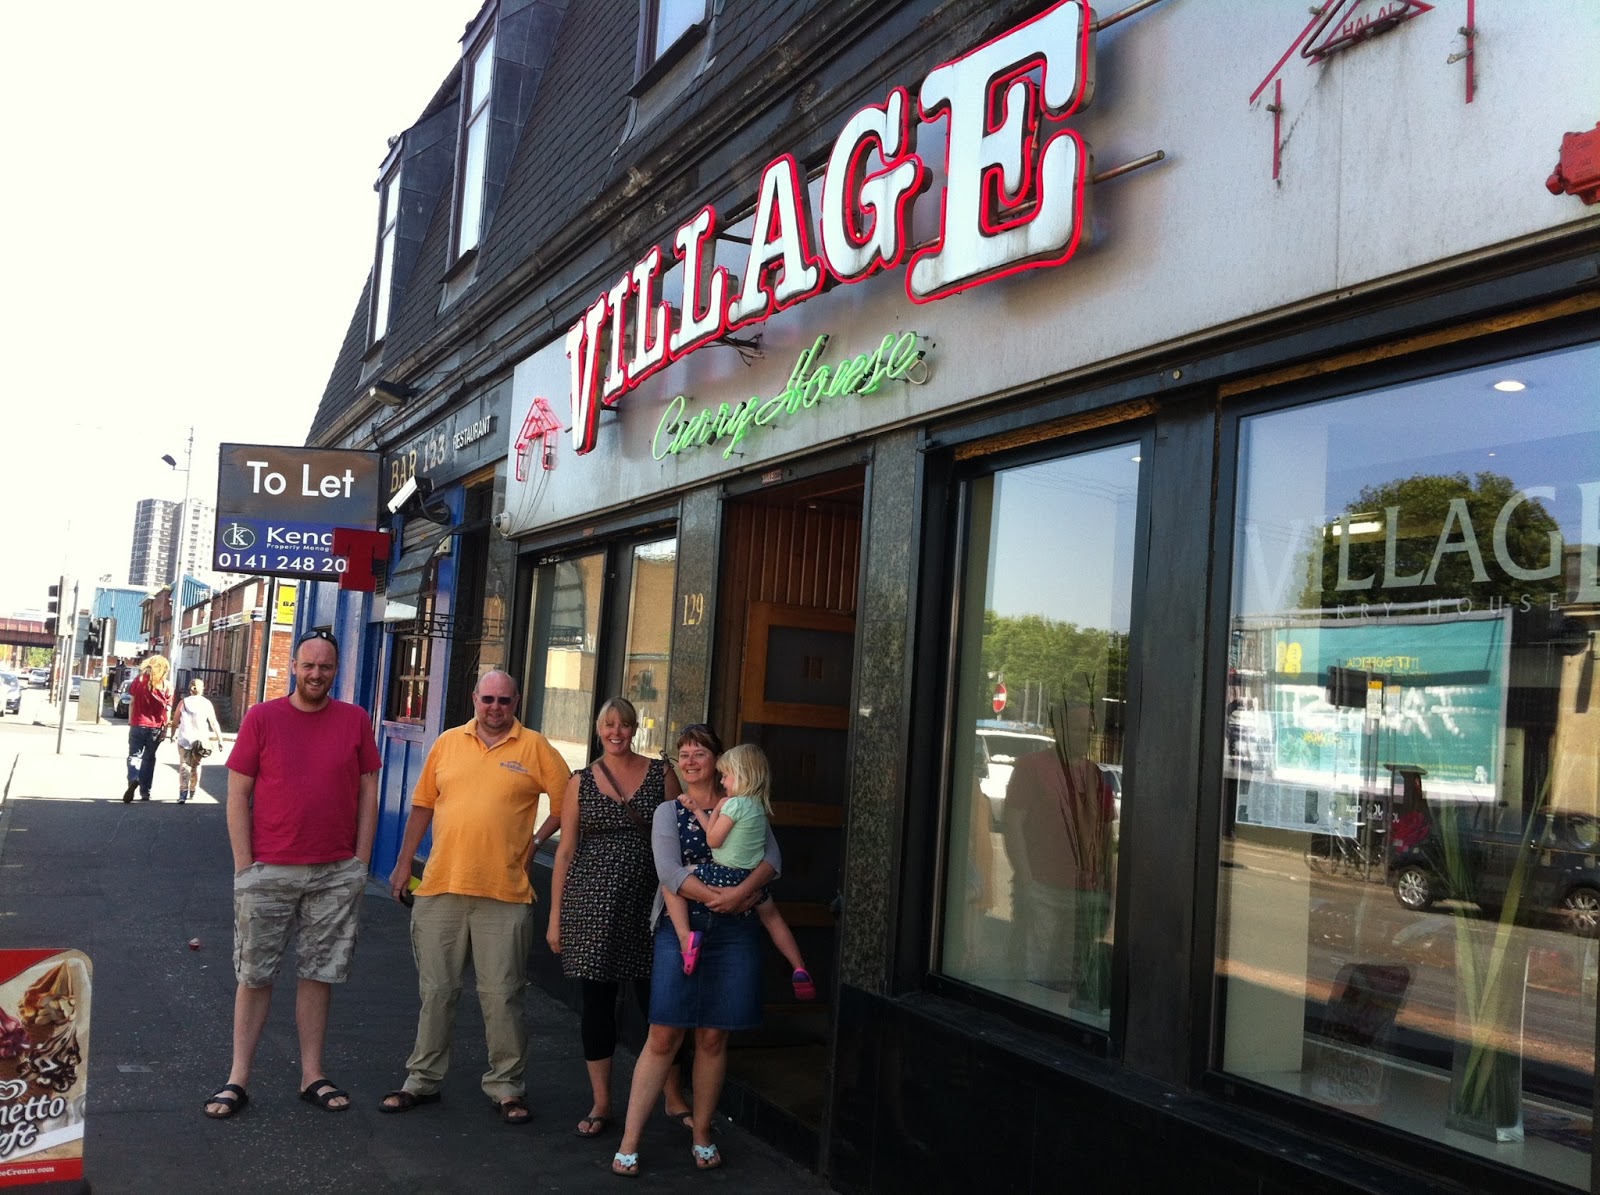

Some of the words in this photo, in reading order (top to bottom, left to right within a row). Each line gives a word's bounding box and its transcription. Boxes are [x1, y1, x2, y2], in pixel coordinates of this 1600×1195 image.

[565, 0, 1094, 455] VILLAGE
[653, 395, 759, 461] Curry
[755, 332, 925, 425] House
[390, 449, 417, 493] BAR
[423, 434, 446, 472] 123
[453, 415, 491, 451] RESTAURANT
[246, 460, 287, 496] To
[301, 463, 355, 498] Let
[218, 552, 267, 569] 0141
[276, 556, 315, 571] 248
[266, 543, 300, 552] Property
[303, 545, 333, 553] Manag
[682, 592, 704, 626] 129
[1289, 602, 1394, 622] URRY
[1427, 592, 1560, 617] HOUSE
